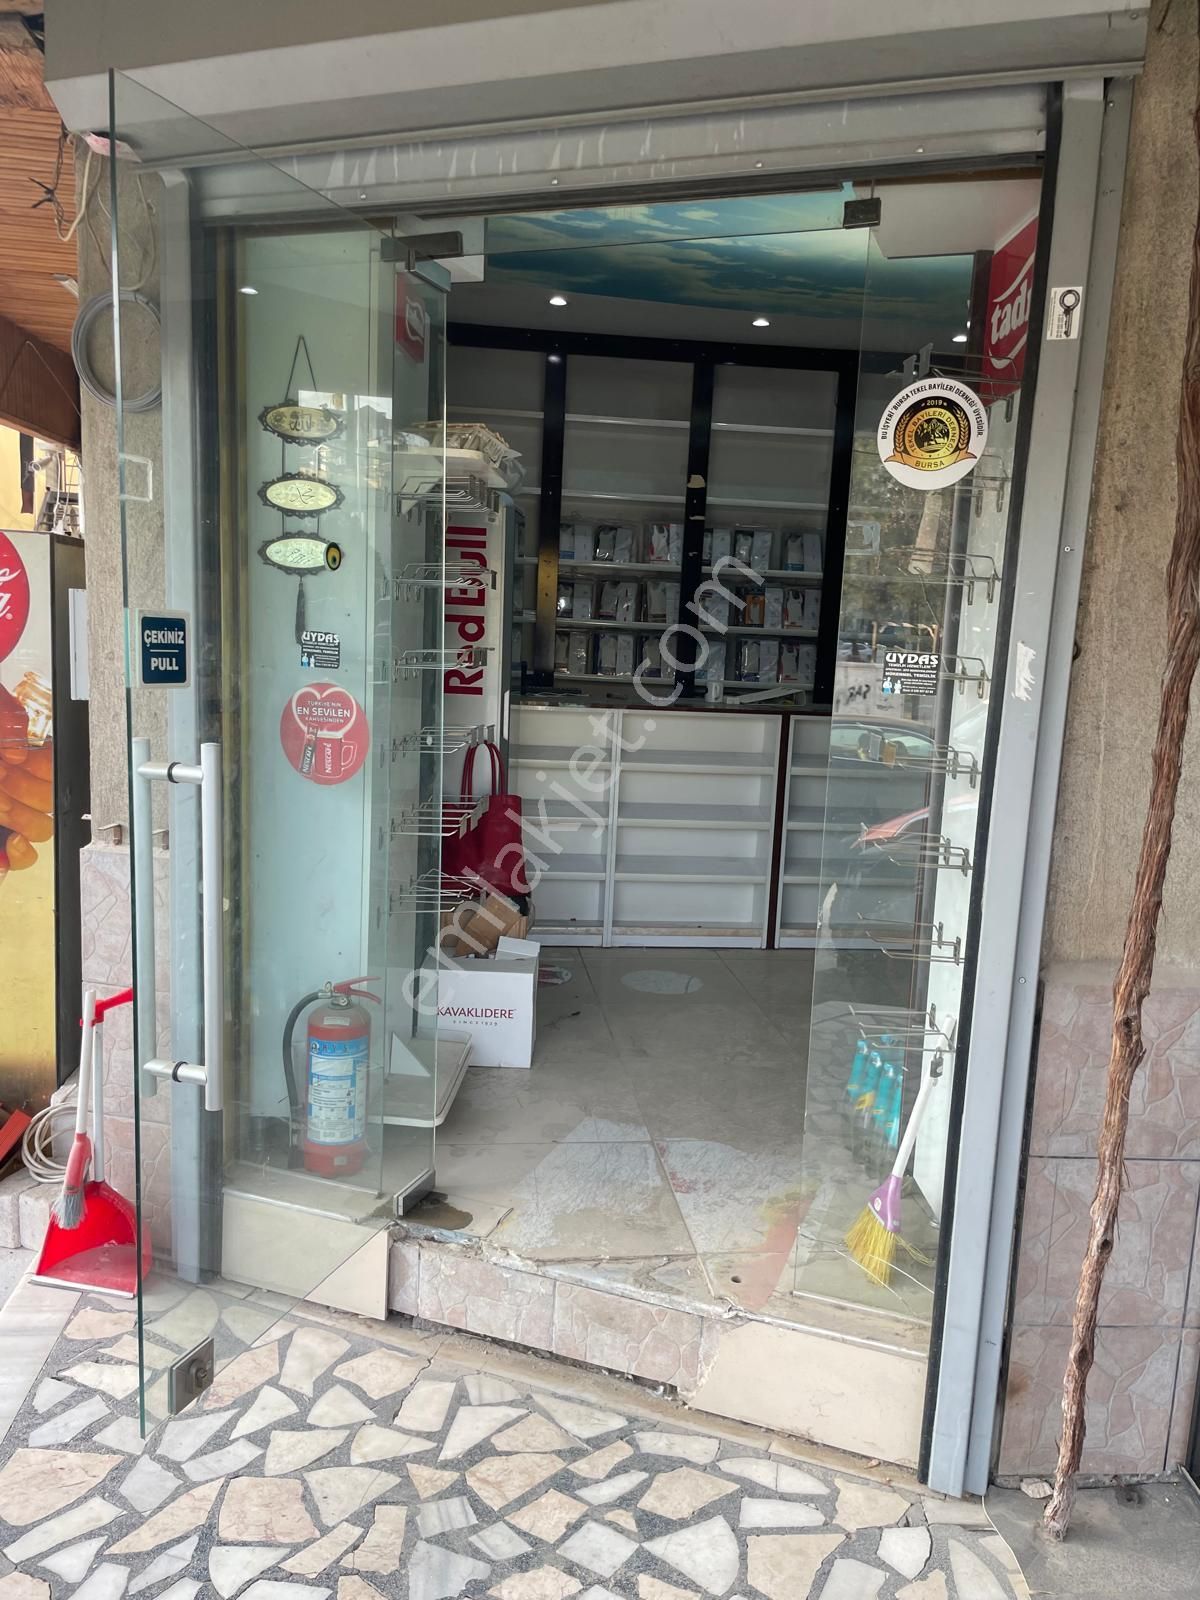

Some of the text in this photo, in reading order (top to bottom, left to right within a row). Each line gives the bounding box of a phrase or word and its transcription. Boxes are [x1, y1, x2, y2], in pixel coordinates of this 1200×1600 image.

[881, 432, 888, 440] BU
[910, 386, 927, 397] TEKEL
[928, 382, 957, 393] BAYİLERİ
[914, 460, 945, 469] BURSA
[144, 627, 185, 647] ÇEKİNİZ
[150, 657, 179, 671] PULL
[297, 707, 350, 717] EN SEVİLEN
[437, 1006, 515, 1019] KAVAKLIDERE
